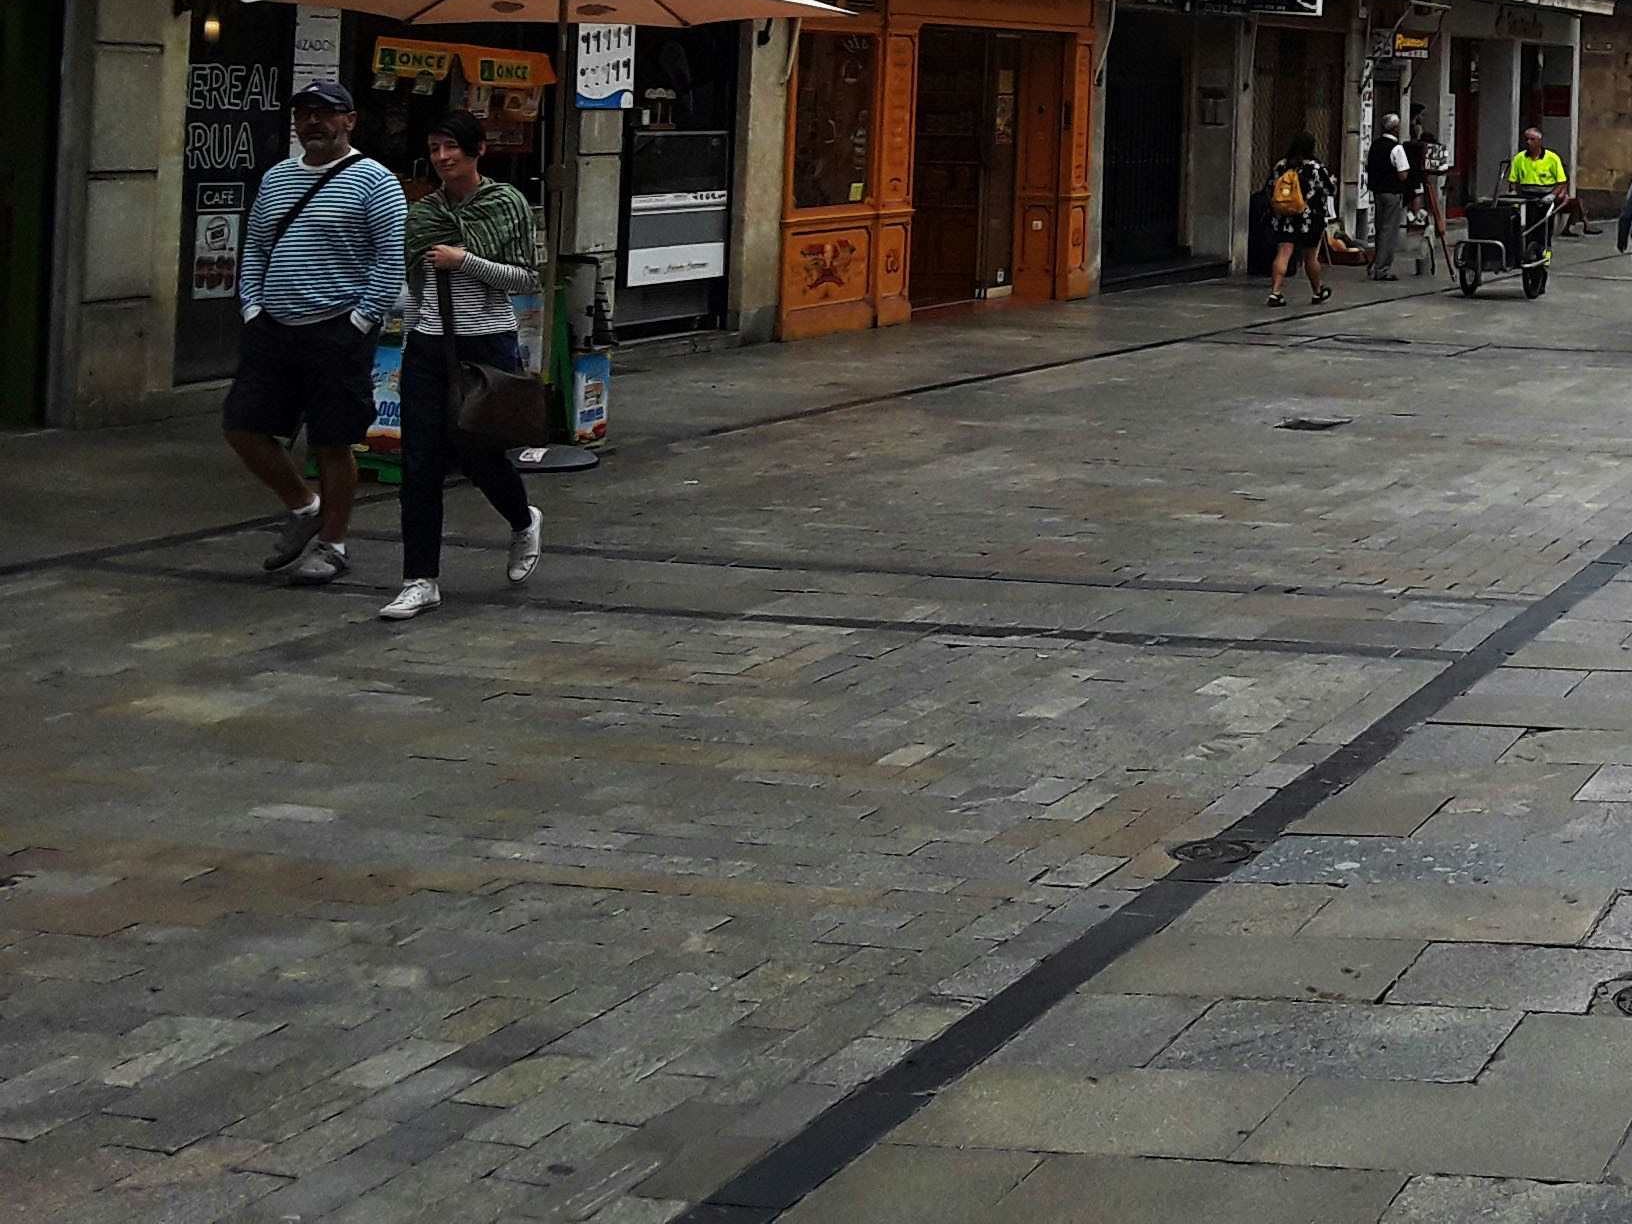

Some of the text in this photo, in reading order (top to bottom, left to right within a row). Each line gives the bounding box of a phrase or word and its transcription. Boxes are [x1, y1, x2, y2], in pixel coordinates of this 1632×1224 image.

[399, 54, 446, 69] ONCE
[497, 65, 529, 80] ONCE
[188, 63, 281, 111] EREAL
[186, 121, 255, 169] RUA
[203, 189, 235, 205] CAFÉ
